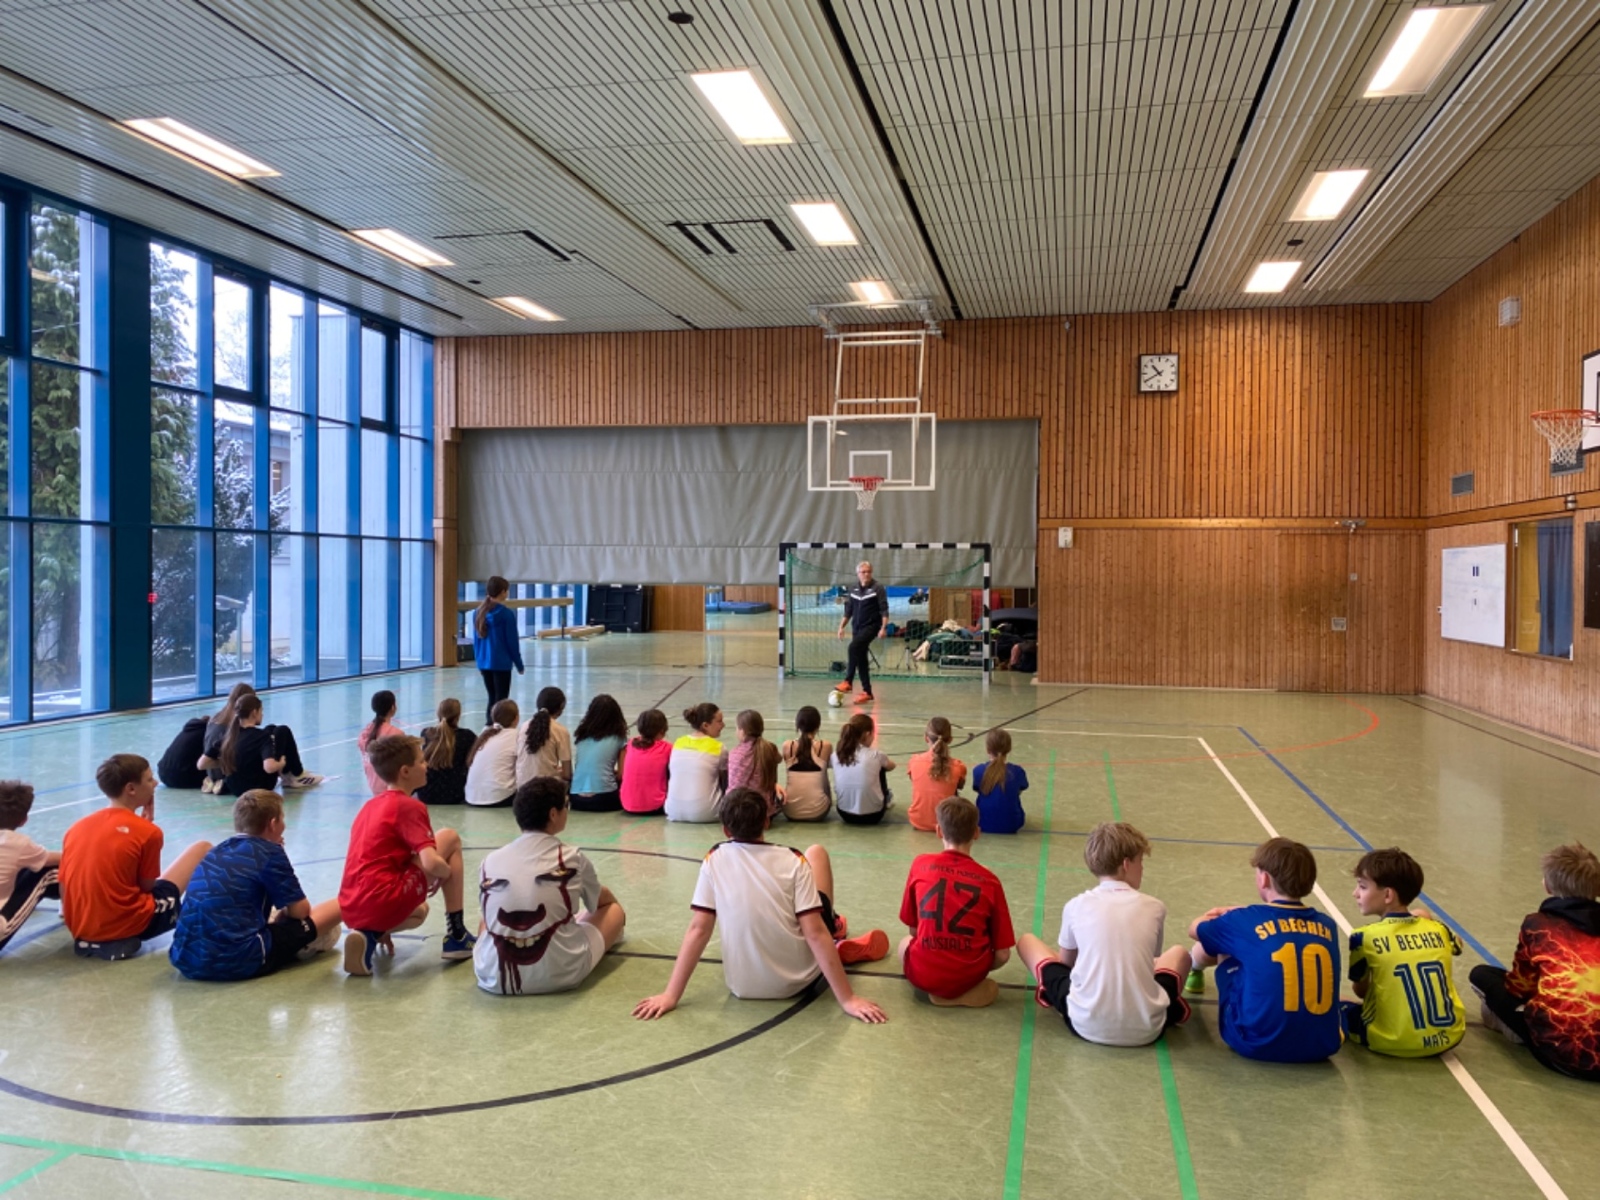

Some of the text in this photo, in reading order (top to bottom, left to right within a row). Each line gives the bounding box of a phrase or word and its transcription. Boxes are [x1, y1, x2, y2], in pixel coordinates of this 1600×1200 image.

[919, 877, 982, 936] 42
[1254, 917, 1332, 942] SV BECHEN
[1372, 931, 1445, 955] SV BECHEN
[1271, 942, 1334, 1015] 10
[1393, 960, 1456, 1030] 10
[1422, 1030, 1450, 1049] MATS
